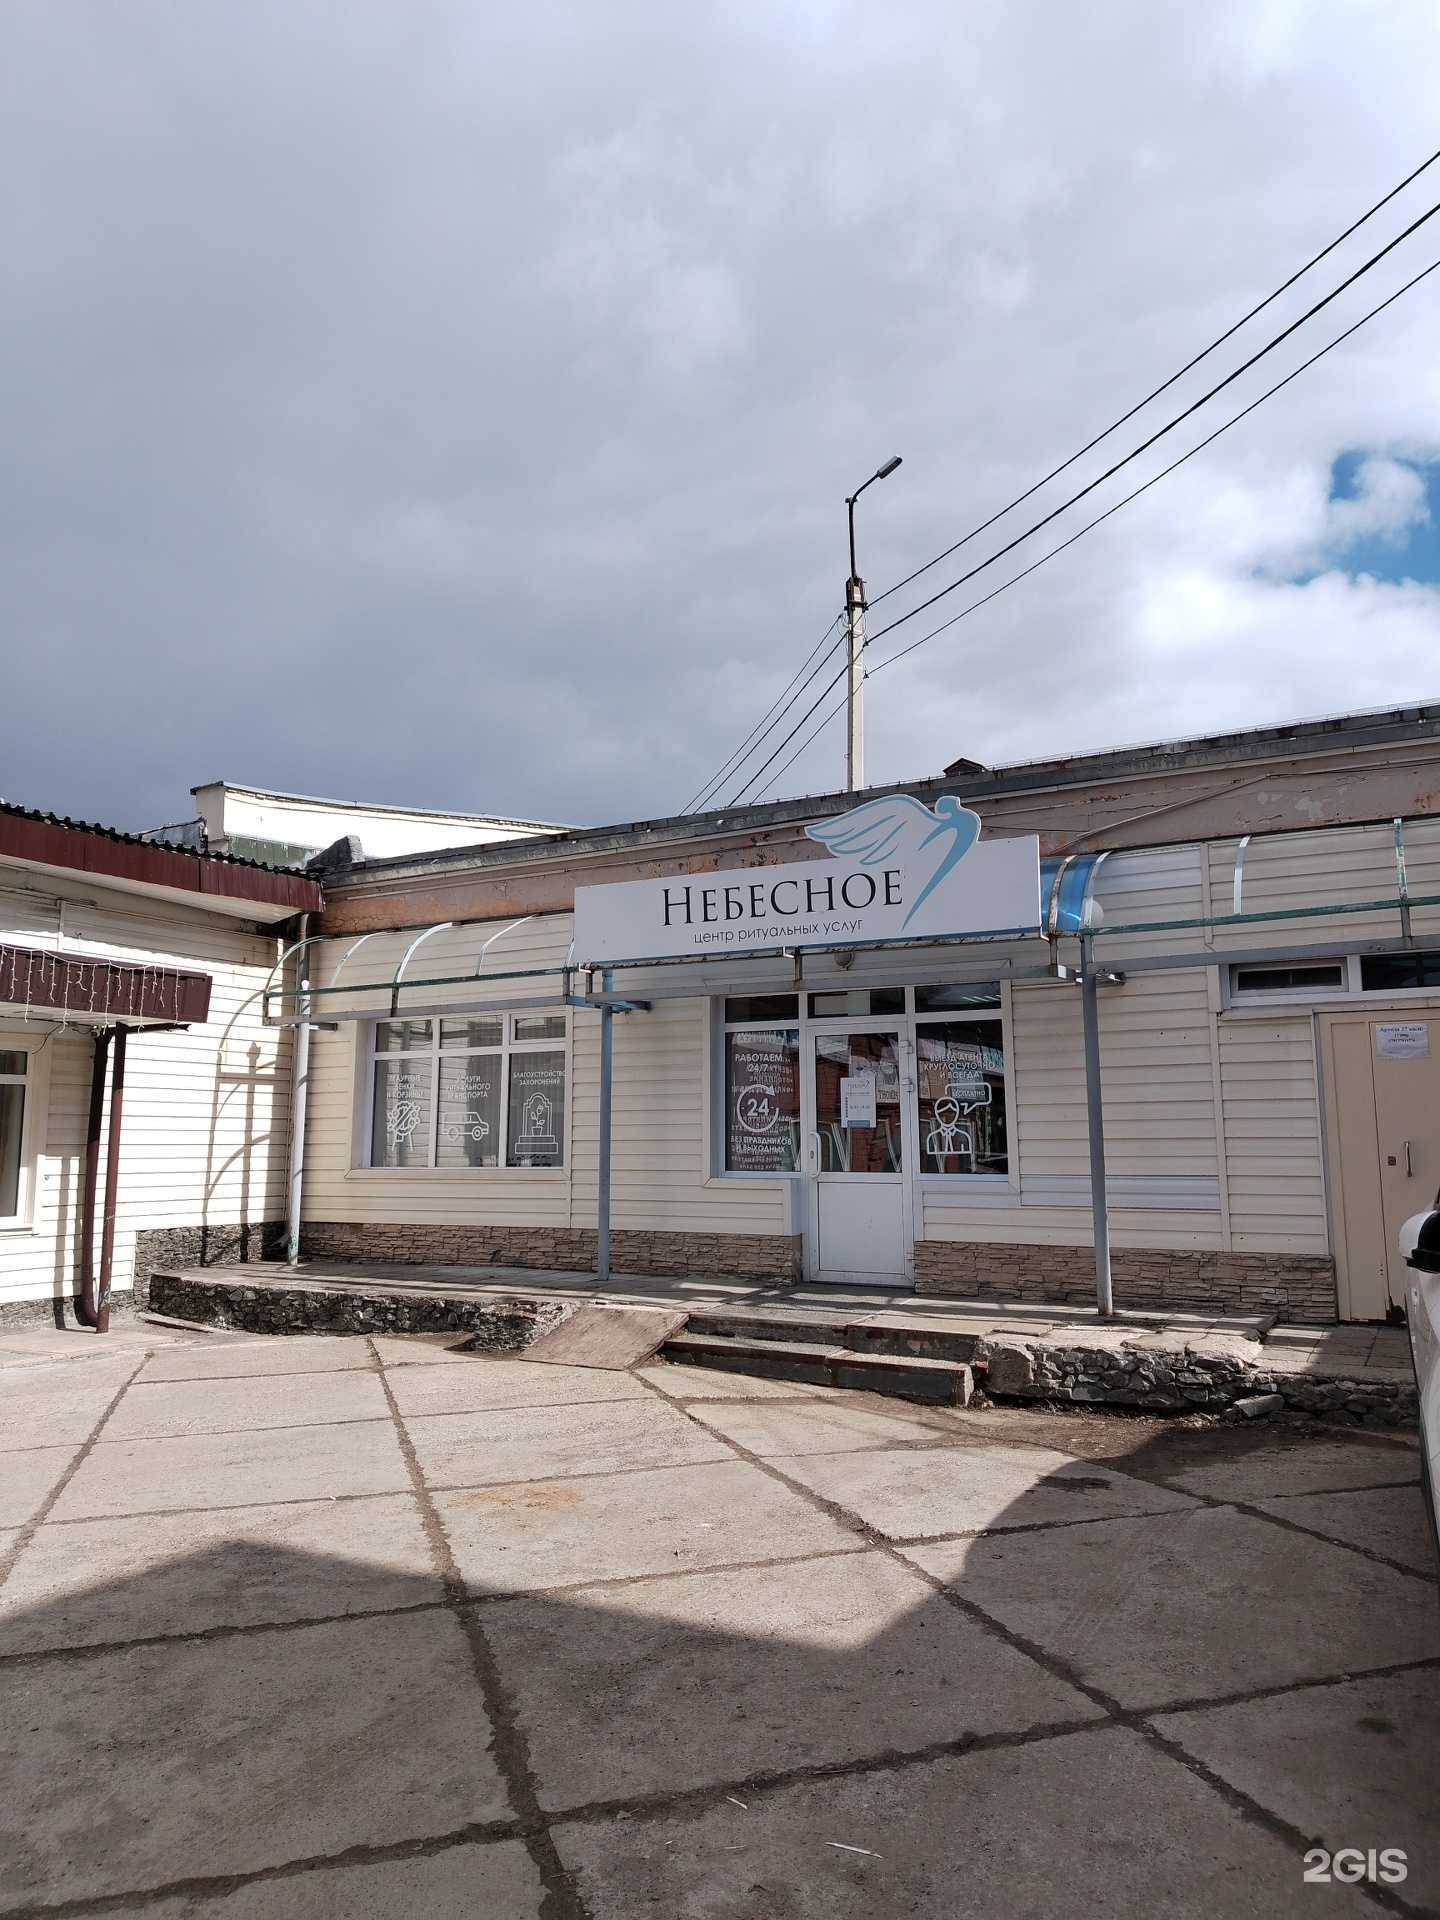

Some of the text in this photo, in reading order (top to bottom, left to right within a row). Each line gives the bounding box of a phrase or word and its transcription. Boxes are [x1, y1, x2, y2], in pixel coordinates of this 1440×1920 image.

[694, 919, 863, 944] центр ритуальных услуг
[735, 1053, 783, 1062] РАБОТАЕМ
[925, 1062, 996, 1071] КРУГЛОСУТОЧНО
[747, 1098, 769, 1116] 24
[744, 1136, 792, 1145] ПРАЗДНИКОВ
